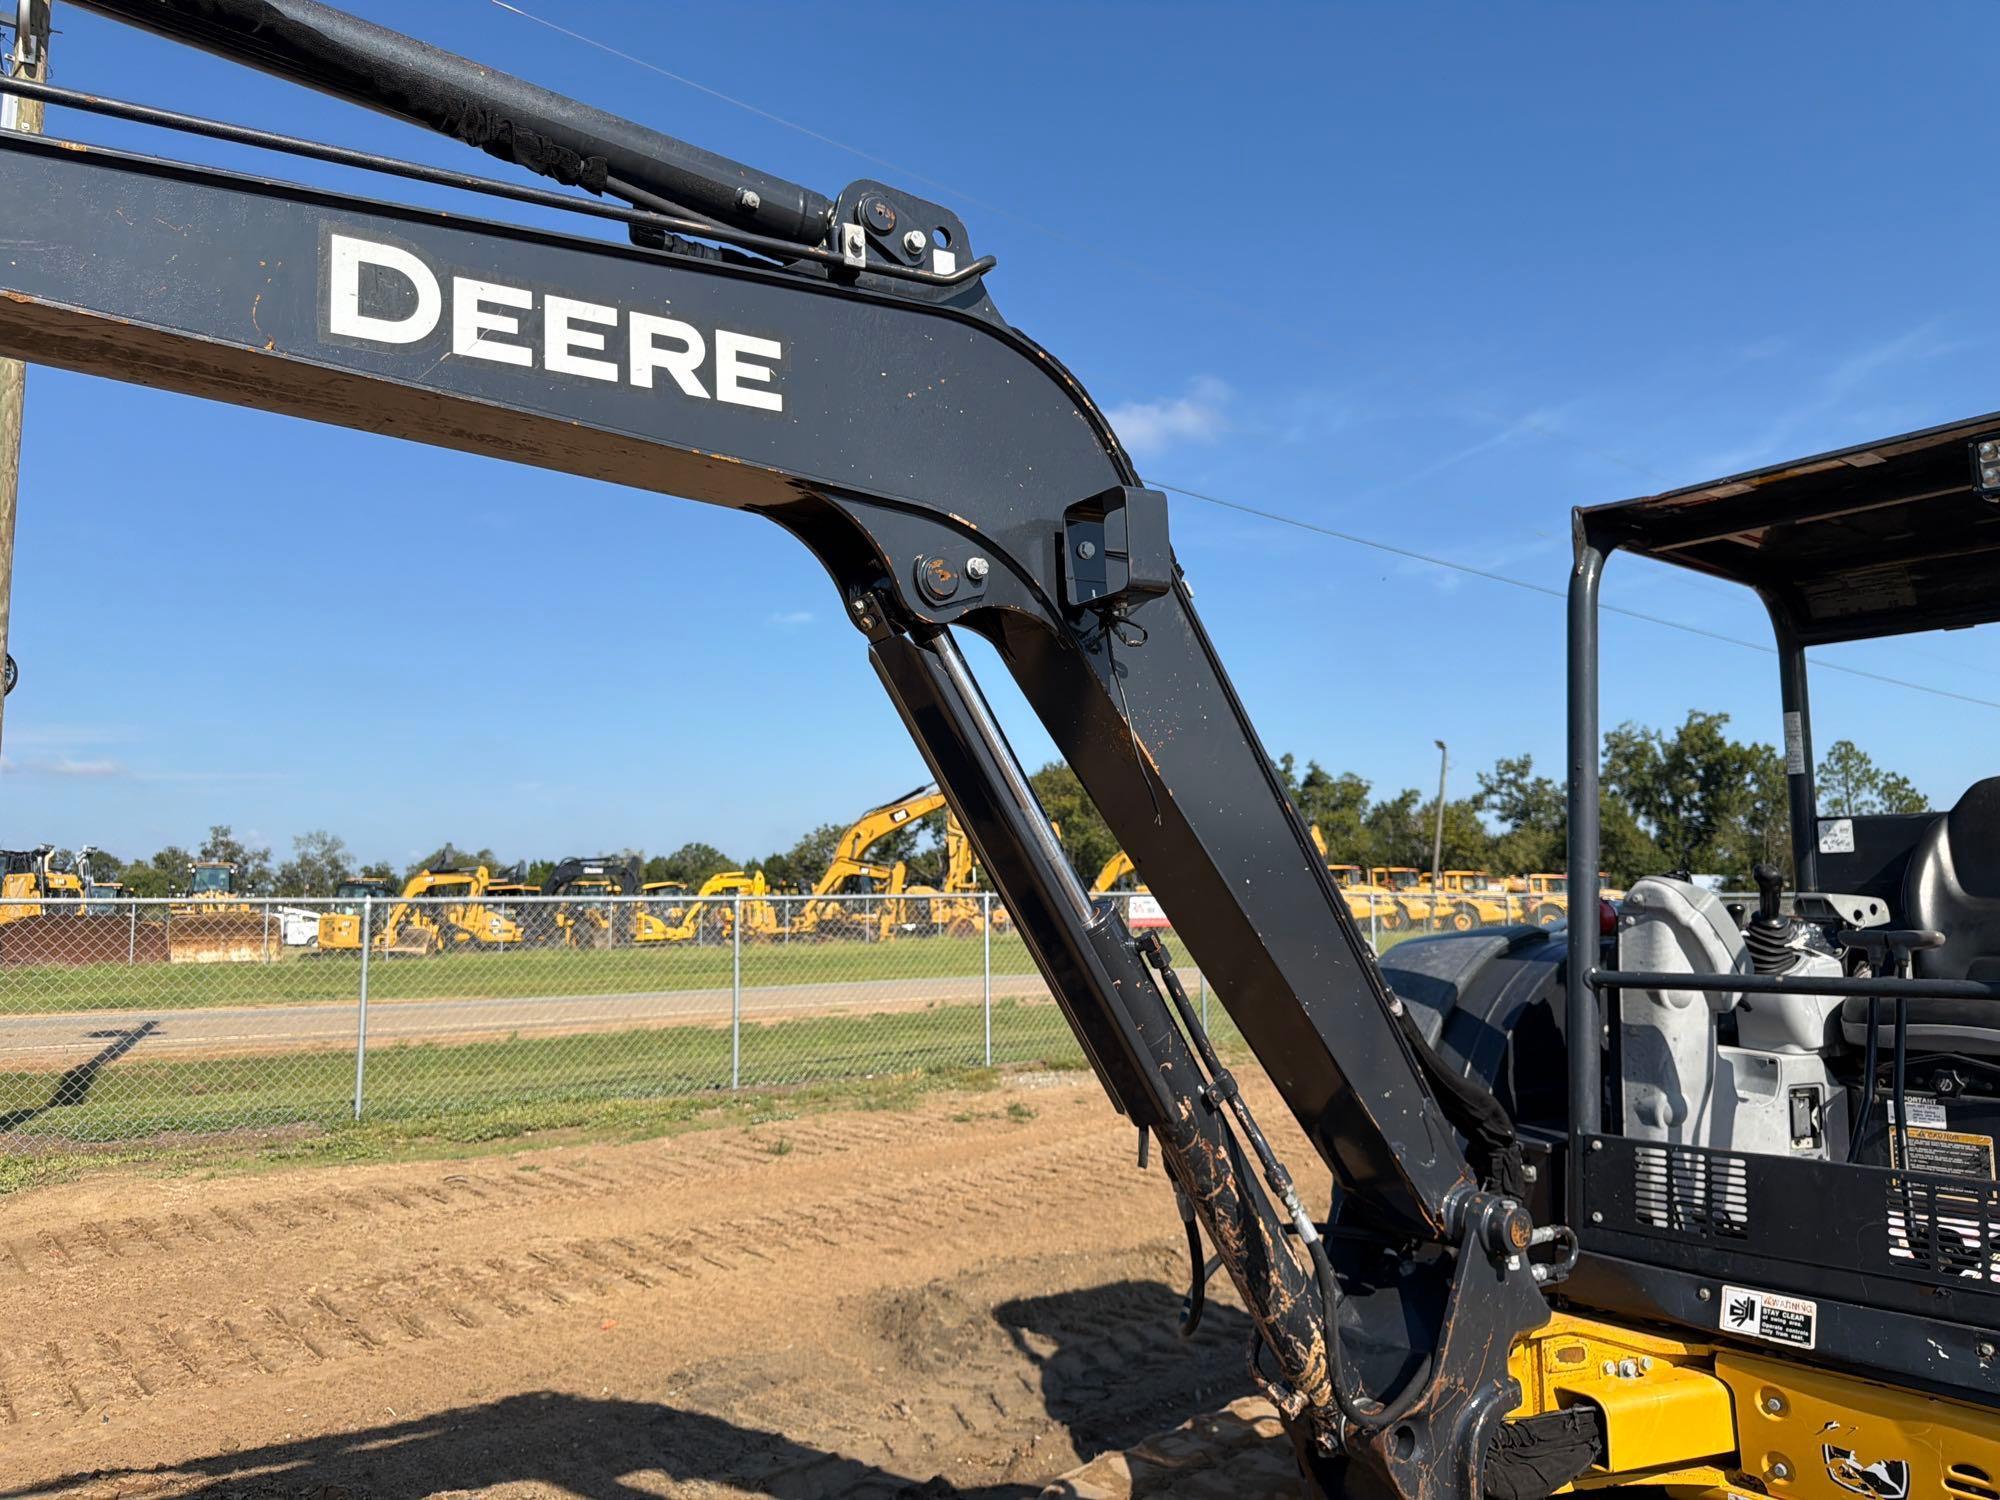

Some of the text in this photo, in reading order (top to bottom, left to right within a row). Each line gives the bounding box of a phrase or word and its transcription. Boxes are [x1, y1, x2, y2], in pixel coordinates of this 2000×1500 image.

[330, 234, 783, 412] DEERE
[1771, 1299, 1813, 1314] WARNING
[1762, 1308, 1805, 1322] STAY CLEAR
[1770, 1317, 1786, 1325] swing
[1761, 1322, 1809, 1336] Operate controls
